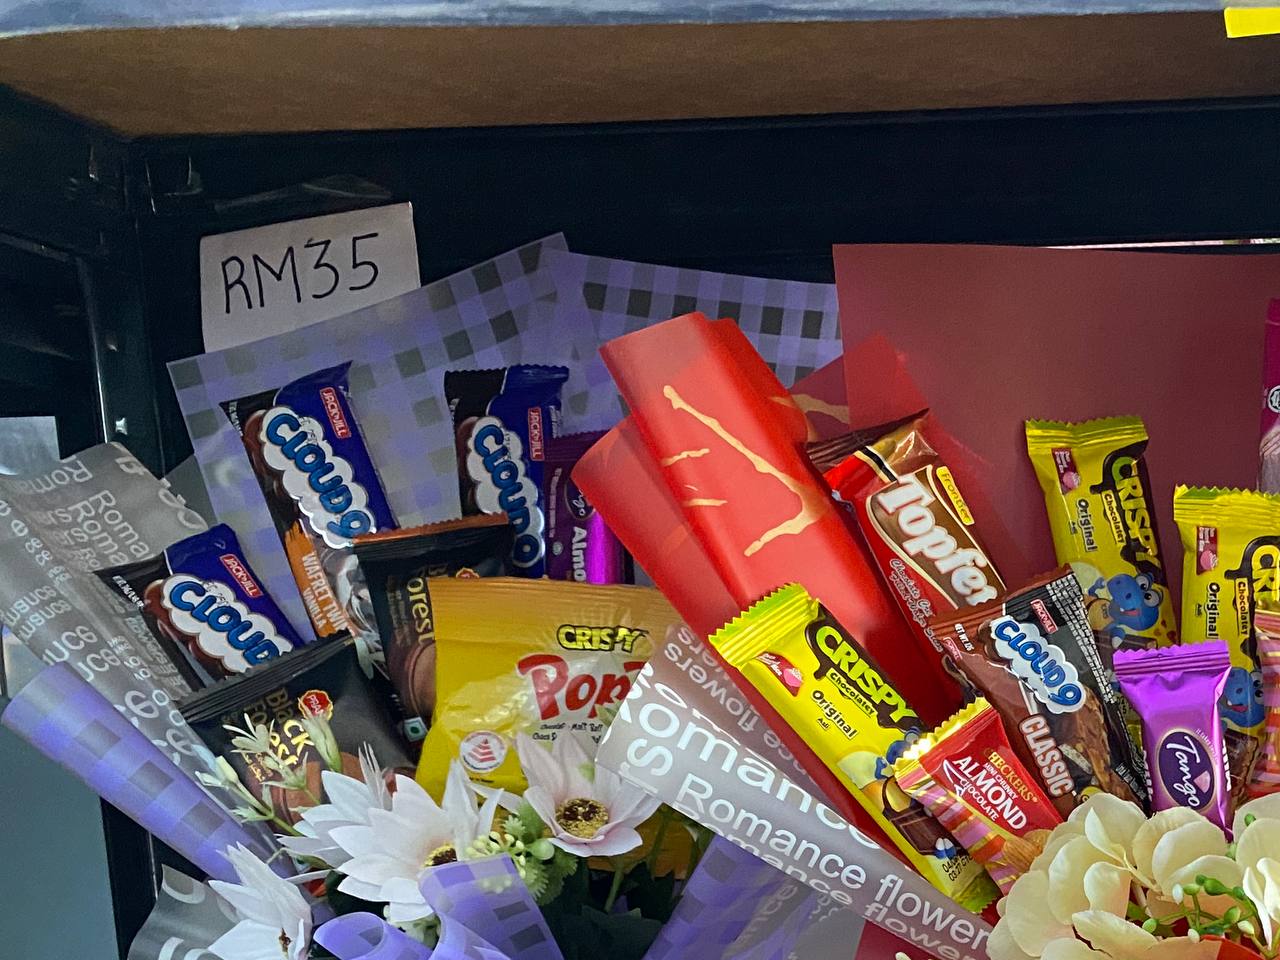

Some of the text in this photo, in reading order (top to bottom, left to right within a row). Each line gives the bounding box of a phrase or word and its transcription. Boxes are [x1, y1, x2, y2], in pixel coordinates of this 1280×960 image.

[220, 231, 380, 314] RM35
[266, 413, 371, 539] CLOUD 9
[474, 425, 531, 534] CLOUD
[68, 501, 130, 566] Roma
[90, 490, 156, 558] Roma
[877, 472, 998, 607] Topfer
[1076, 498, 1098, 552] Original
[1111, 456, 1162, 568] CRISPY
[302, 551, 333, 603] WAFRET
[572, 526, 588, 582] Almo
[170, 581, 280, 666] CLOUD
[302, 586, 327, 631] VANILLA
[407, 577, 437, 647] orest
[556, 623, 649, 653] CRISPY
[1207, 581, 1221, 638] Original
[816, 626, 918, 722] CRISPY
[828, 671, 876, 715] Chocolatey
[994, 619, 1083, 707] CLOUD 9
[811, 689, 859, 738] Original
[988, 751, 1034, 803] HECKERS
[1021, 716, 1076, 798] CLASSIC
[1165, 735, 1201, 808] Tango
[954, 755, 1028, 830] ALMOND
[960, 778, 1000, 822] CHOCOLATE
[672, 772, 991, 949] Romance flower
